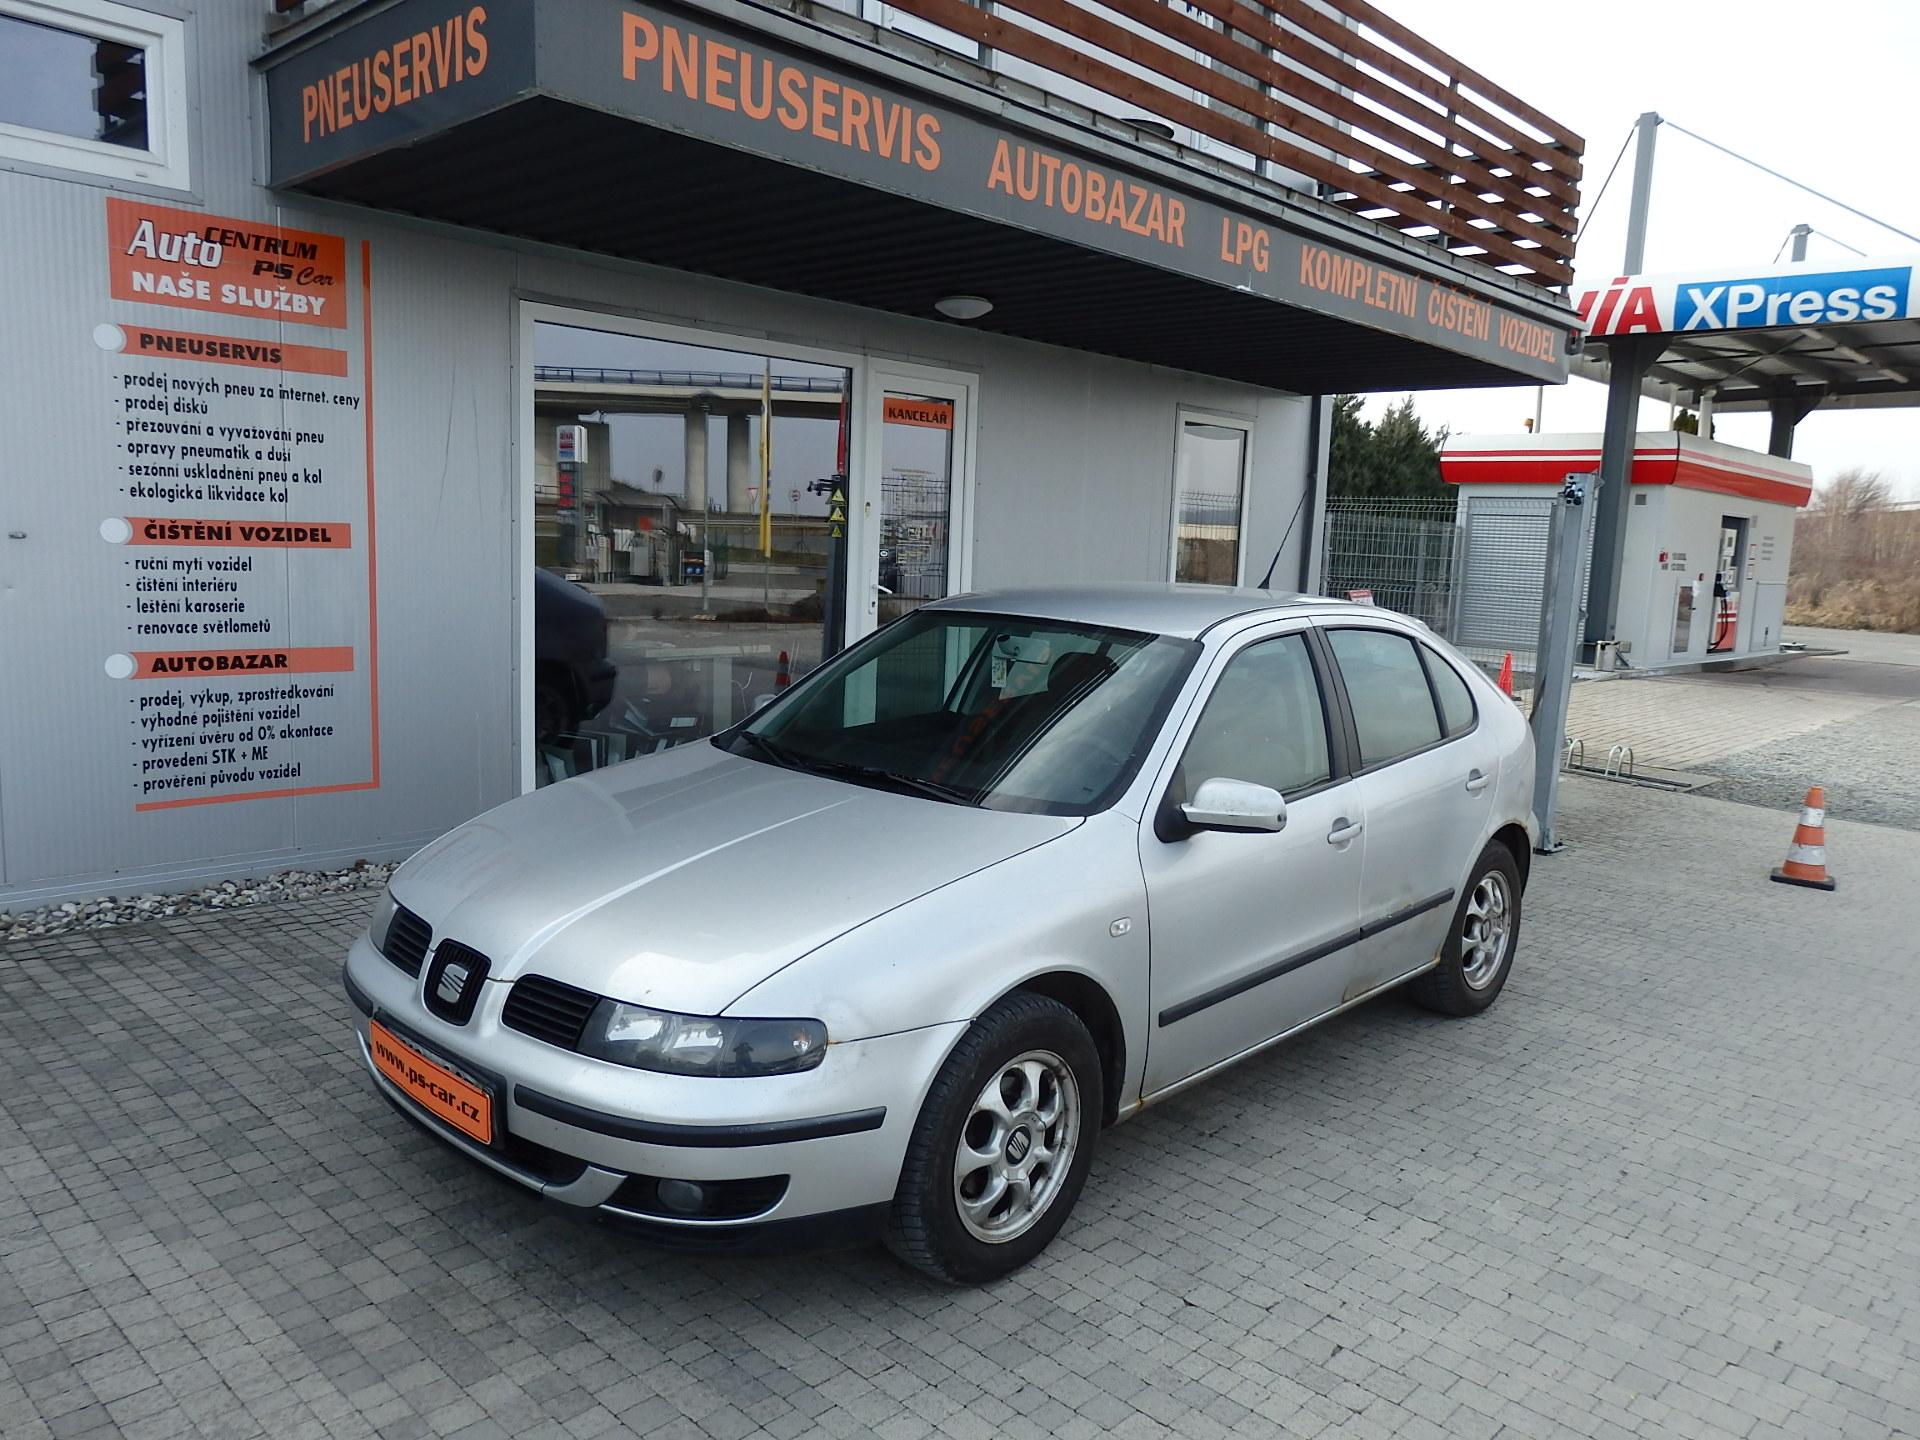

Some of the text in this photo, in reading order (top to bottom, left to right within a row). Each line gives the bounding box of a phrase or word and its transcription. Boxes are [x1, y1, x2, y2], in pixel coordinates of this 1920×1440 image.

[303, 6, 488, 144] PNEUSERVIS
[622, 11, 1557, 363] PNEUSERVIS AUTOBAZAR LPG KOMPLETNÍ ČIŠTĚNÍ VOZIDEL
[125, 218, 318, 269] Auto CENTRUM
[252, 260, 335, 286] PS Car
[132, 271, 326, 316] NAŠE SLUŽBY
[1683, 284, 1898, 331] XPress
[140, 333, 282, 364] PNEUSERVIS
[124, 372, 360, 410] prodej nových pneu za internet. ceny
[125, 394, 208, 415] prodej disků
[888, 406, 948, 425] KANCELÁŘ
[127, 417, 325, 446] přezouvání a vyvažování pneu
[128, 443, 291, 462] opravy pneumatik a duší
[129, 462, 322, 484] sezónní uskladnění pneu a kol
[130, 481, 288, 503] ekologická likvidace kol
[144, 519, 332, 543] ČIŠTĚNÍ VOZIDEL
[135, 556, 252, 574] ruční mytí vozidel
[136, 576, 238, 592] čištění interiéru
[137, 597, 245, 614] leštění karoserie
[137, 618, 271, 635] renovace světlometů
[151, 654, 288, 673] AUTOBAZAR
[140, 684, 334, 711] prodej, výkup, zprostředkování
[141, 704, 300, 731] výhodné pojištění vozidel
[142, 724, 334, 752] vyřízení úvěru od 0% akontace
[143, 752, 208, 774] provedení
[212, 749, 236, 764] STK
[252, 746, 269, 760] ME
[144, 763, 301, 795] prověření původu vozidel
[375, 1040, 481, 1124] www.ps-car.cz
